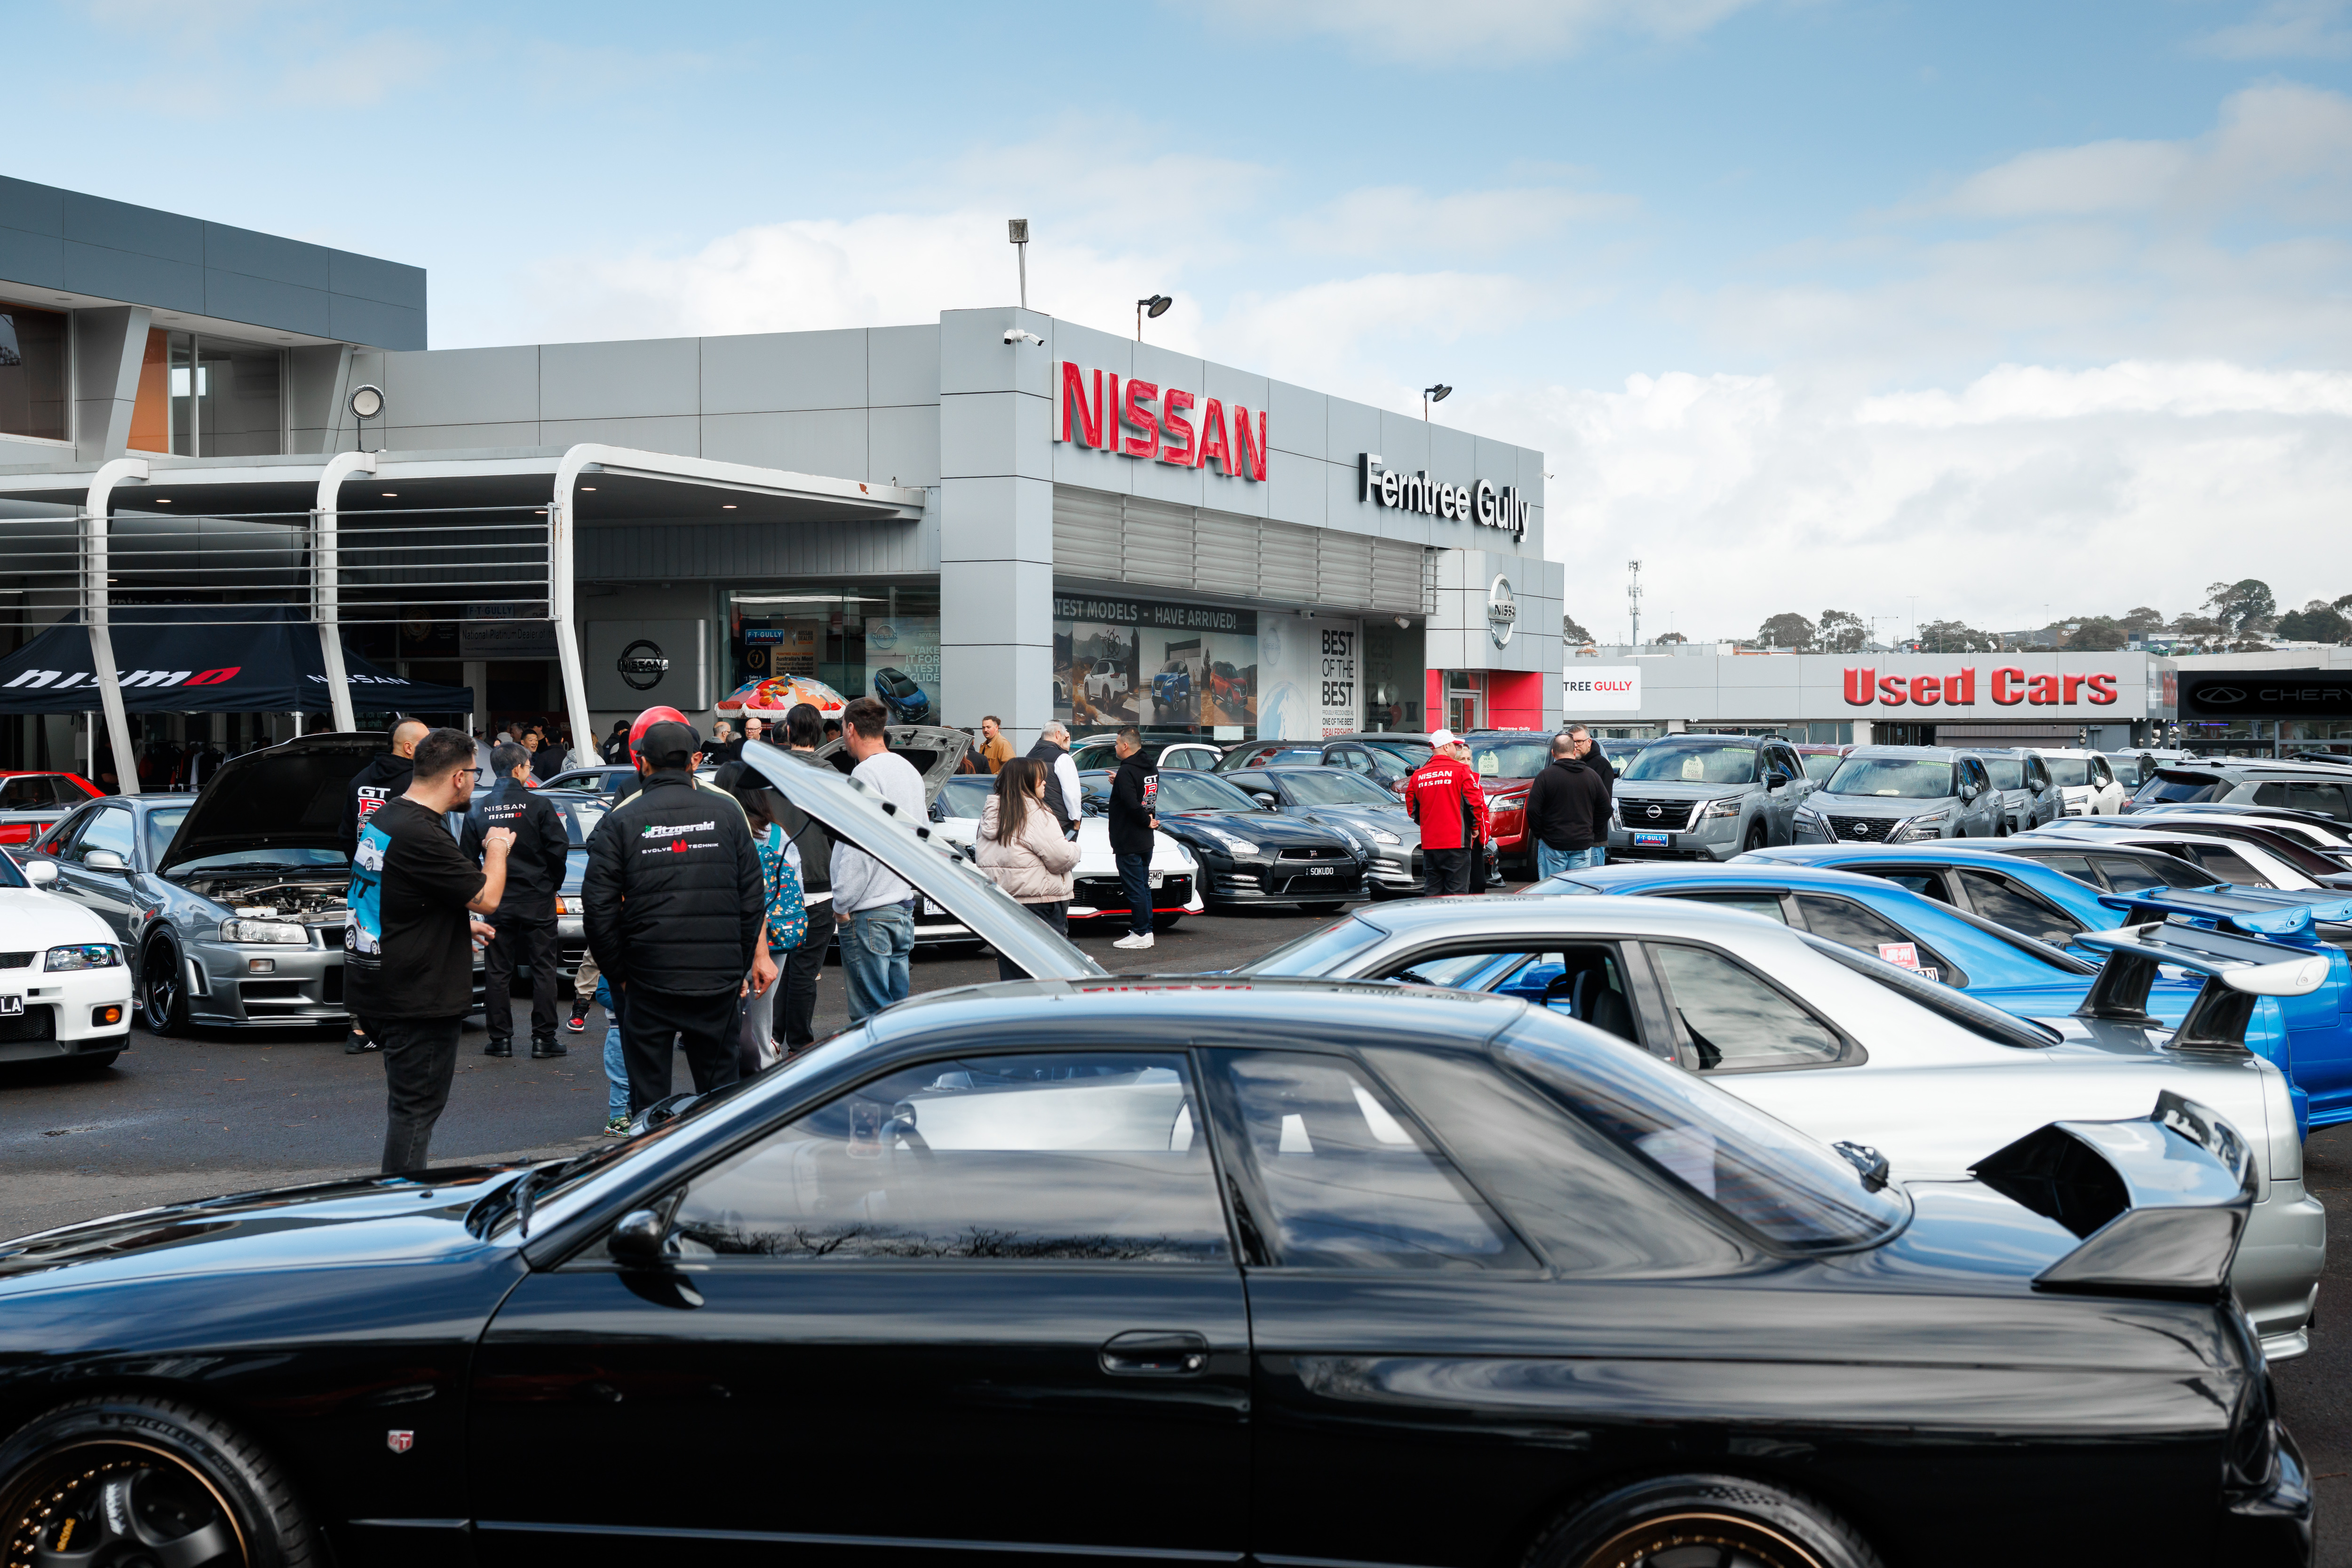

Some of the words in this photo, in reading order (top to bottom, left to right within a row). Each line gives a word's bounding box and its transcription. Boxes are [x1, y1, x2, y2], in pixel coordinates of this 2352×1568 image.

[1053, 360, 1266, 482] NISSAN
[1359, 453, 1471, 521] Ferntree
[1471, 478, 1531, 543] Gully
[1053, 598, 1084, 617] ATEST
[1087, 601, 1137, 621] MODELS
[1155, 606, 1184, 625] HAVE
[1187, 610, 1236, 629] ARRIVED!
[1494, 605, 1516, 617] NISSA
[462, 629, 488, 640] National
[490, 629, 517, 640] Platinum
[518, 629, 538, 639] Dealer
[539, 629, 546, 639] of
[1322, 629, 1354, 656] BEST
[914, 646, 940, 654] TAKE
[906, 655, 915, 663] IT
[918, 655, 940, 663] FOR
[620, 661, 662, 669] NISSAN
[903, 664, 911, 673] A
[914, 664, 940, 673] TEST
[1322, 658, 1335, 677] OF
[1337, 660, 1354, 678] THE
[306, 675, 411, 685] NSSAN
[909, 673, 940, 682] GLIDE
[1563, 682, 1591, 691] TREE
[1594, 681, 1633, 691] GULLY
[1844, 667, 1975, 707] Used
[1991, 665, 2118, 706] Cars
[1322, 681, 1354, 707] BEST
[2259, 689, 2352, 700] CHERY
[1322, 728, 1354, 737] DEALERSHIPS
[1144, 774, 1158, 784] GT
[1418, 771, 1453, 781] NISSAN
[1418, 779, 1452, 788] nismo
[358, 786, 391, 798] GT
[1143, 782, 1158, 798] R
[358, 797, 387, 817] R
[484, 804, 526, 812] NISSAN
[650, 821, 715, 836] Fitzgerald
[1311, 867, 1334, 876] SOKUDO
[0, 998, 22, 1012] LA
[123, 1415, 206, 1452] MICHELIN
